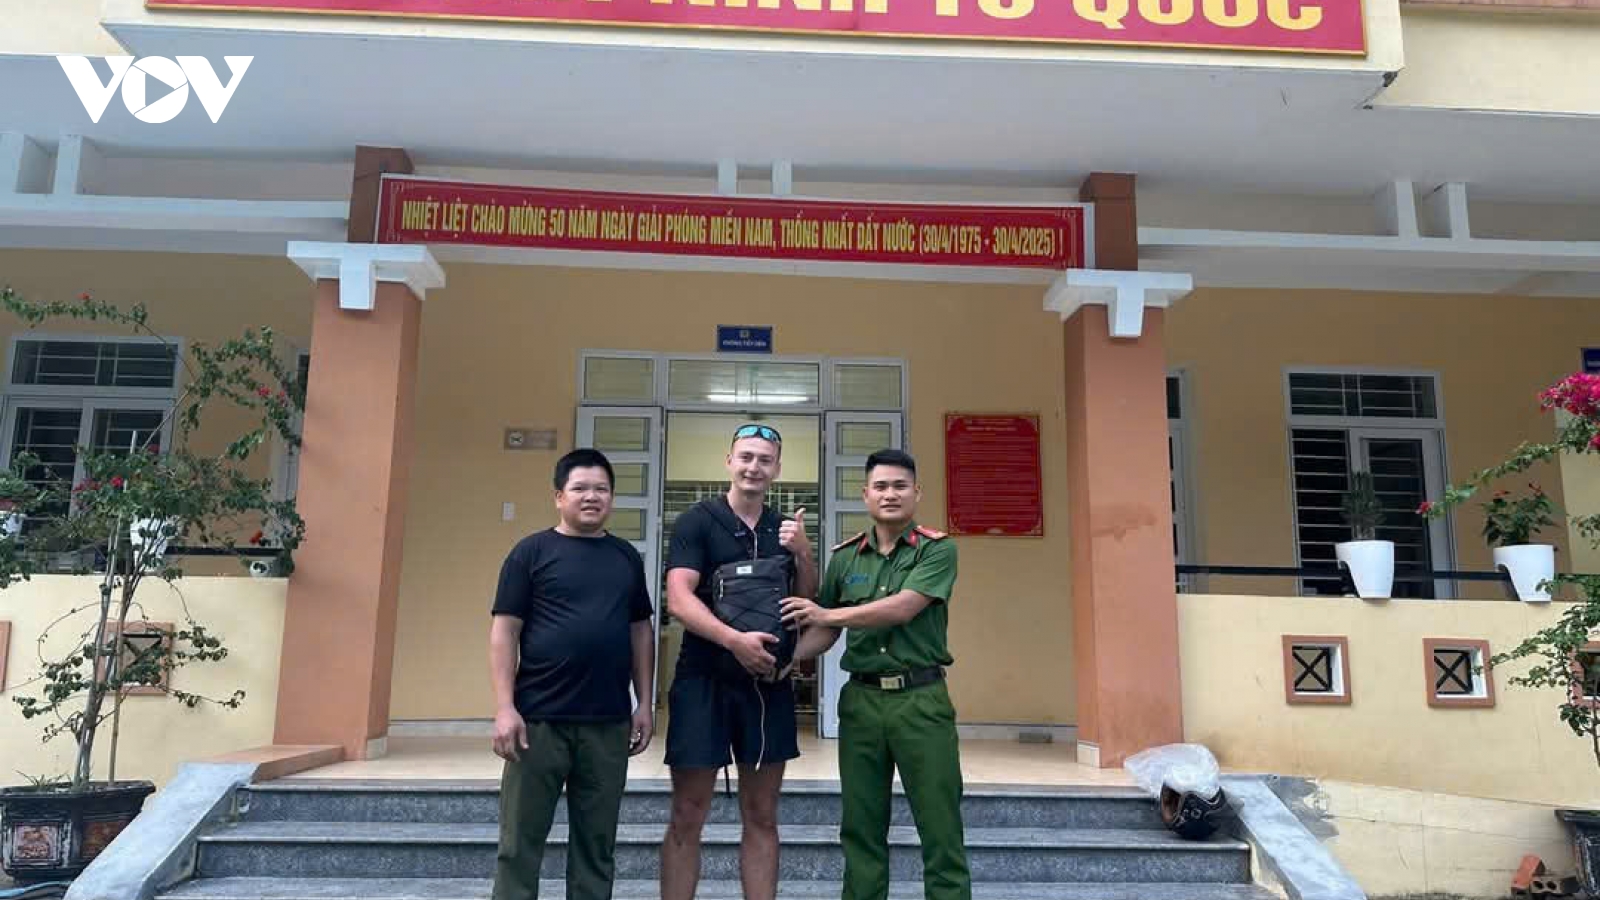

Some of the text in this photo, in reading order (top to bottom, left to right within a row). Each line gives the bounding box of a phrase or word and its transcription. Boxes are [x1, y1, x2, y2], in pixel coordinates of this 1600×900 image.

[402, 195, 439, 237] NHIỆT
[442, 195, 468, 238] LIỆT
[471, 198, 504, 234] CHÀO
[549, 208, 565, 237] 50
[569, 205, 597, 238] NĂM
[601, 205, 634, 241] NGÀY
[637, 205, 662, 241] GIẢI
[664, 207, 706, 244] PHÓNG
[745, 217, 776, 250] NAM,
[780, 210, 818, 248] THỐNG
[822, 212, 853, 250] NHẤT
[882, 217, 915, 251] NƯỚC
[919, 224, 982, 255] (30/4/1975
[993, 226, 1055, 259] 30/4/2025)
